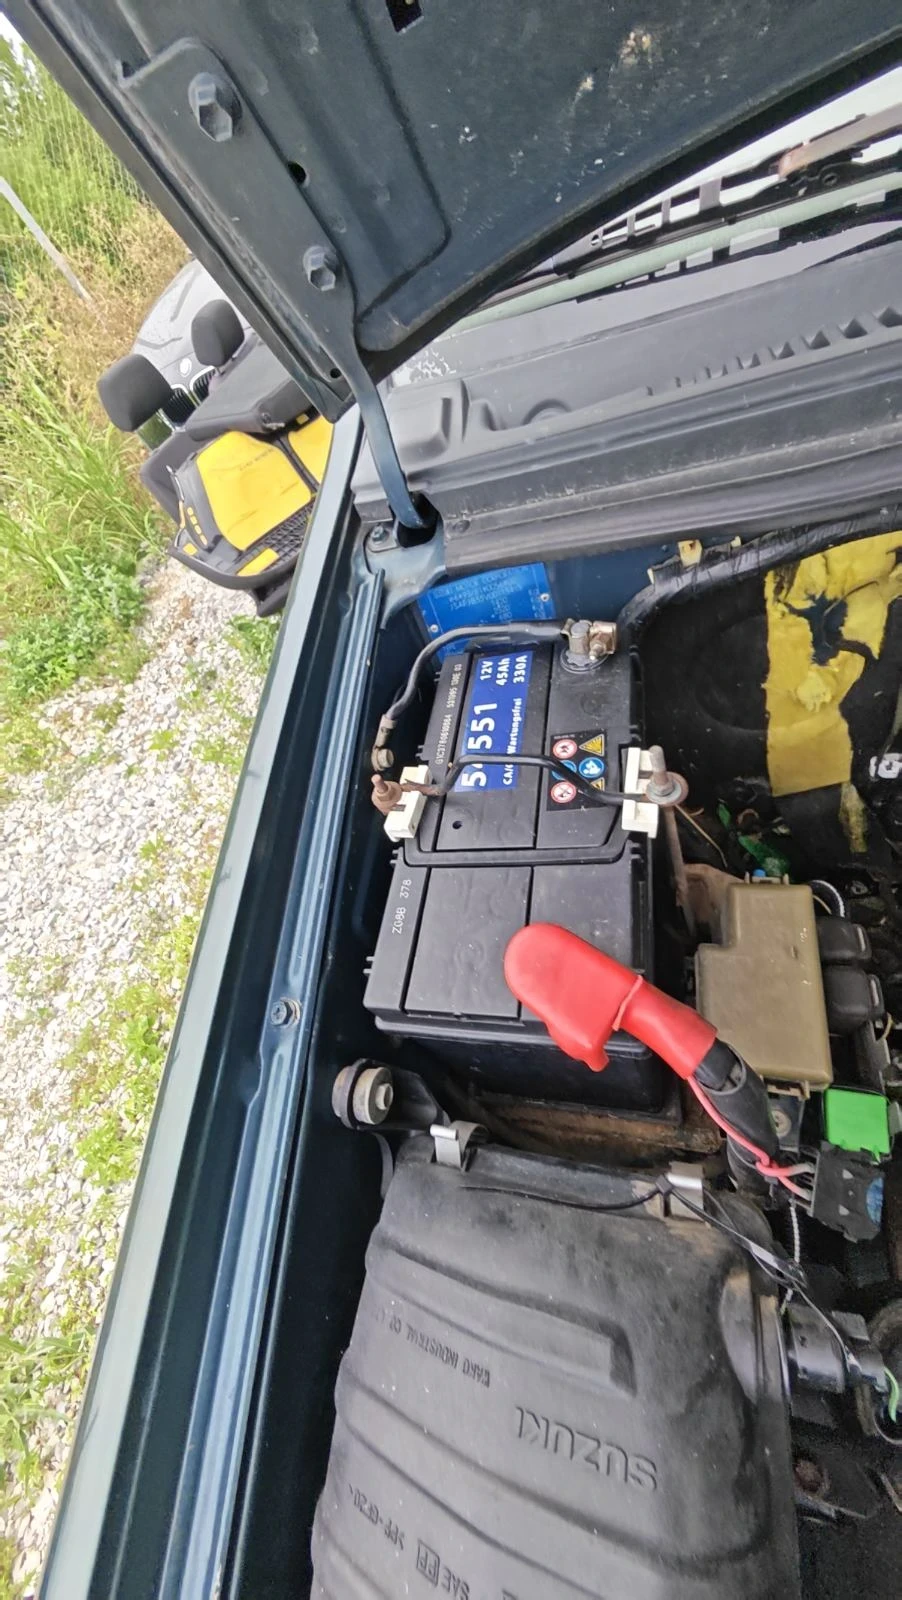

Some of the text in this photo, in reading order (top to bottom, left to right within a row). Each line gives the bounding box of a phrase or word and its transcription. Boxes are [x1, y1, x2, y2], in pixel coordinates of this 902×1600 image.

[480, 661, 494, 681] 12V
[496, 657, 511, 686] 45Ah
[513, 655, 528, 684] 330A
[507, 698, 523, 754] Wartungsfrei
[400, 879, 412, 898] 378
[515, 1406, 658, 1491] SUZUKI
